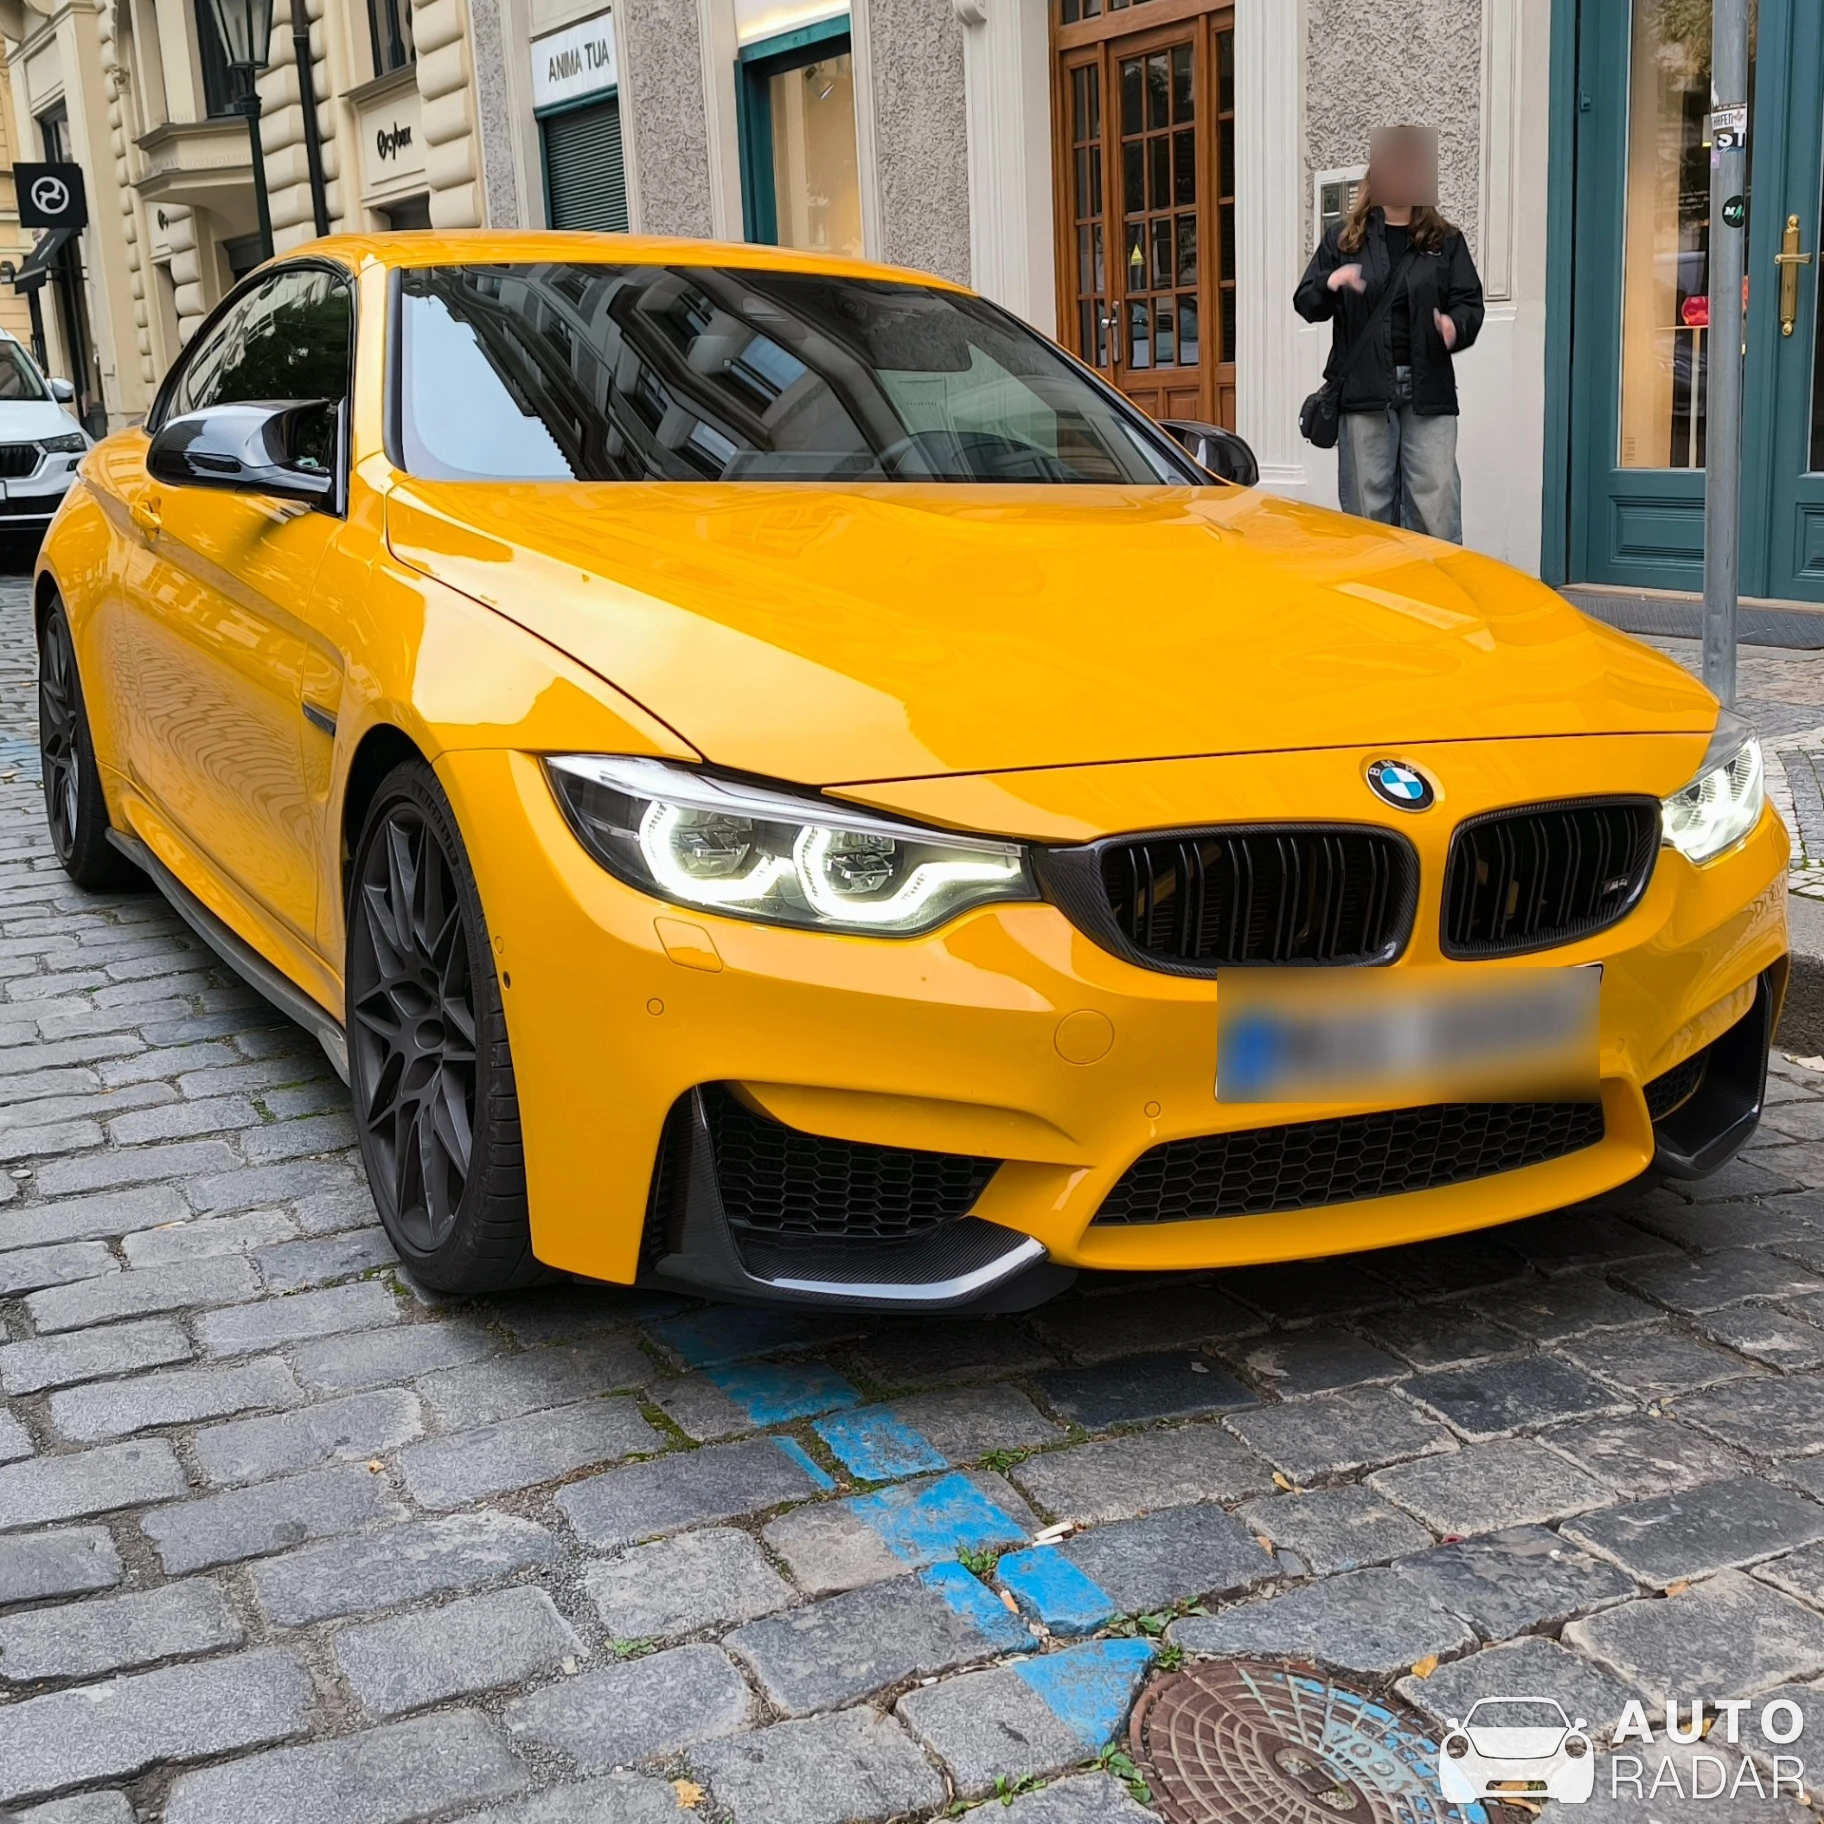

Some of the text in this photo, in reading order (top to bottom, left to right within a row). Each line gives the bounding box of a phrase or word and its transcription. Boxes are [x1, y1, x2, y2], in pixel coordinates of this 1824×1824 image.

[549, 38, 610, 83] ANIMA TUA
[1368, 760, 1417, 777] BMW
